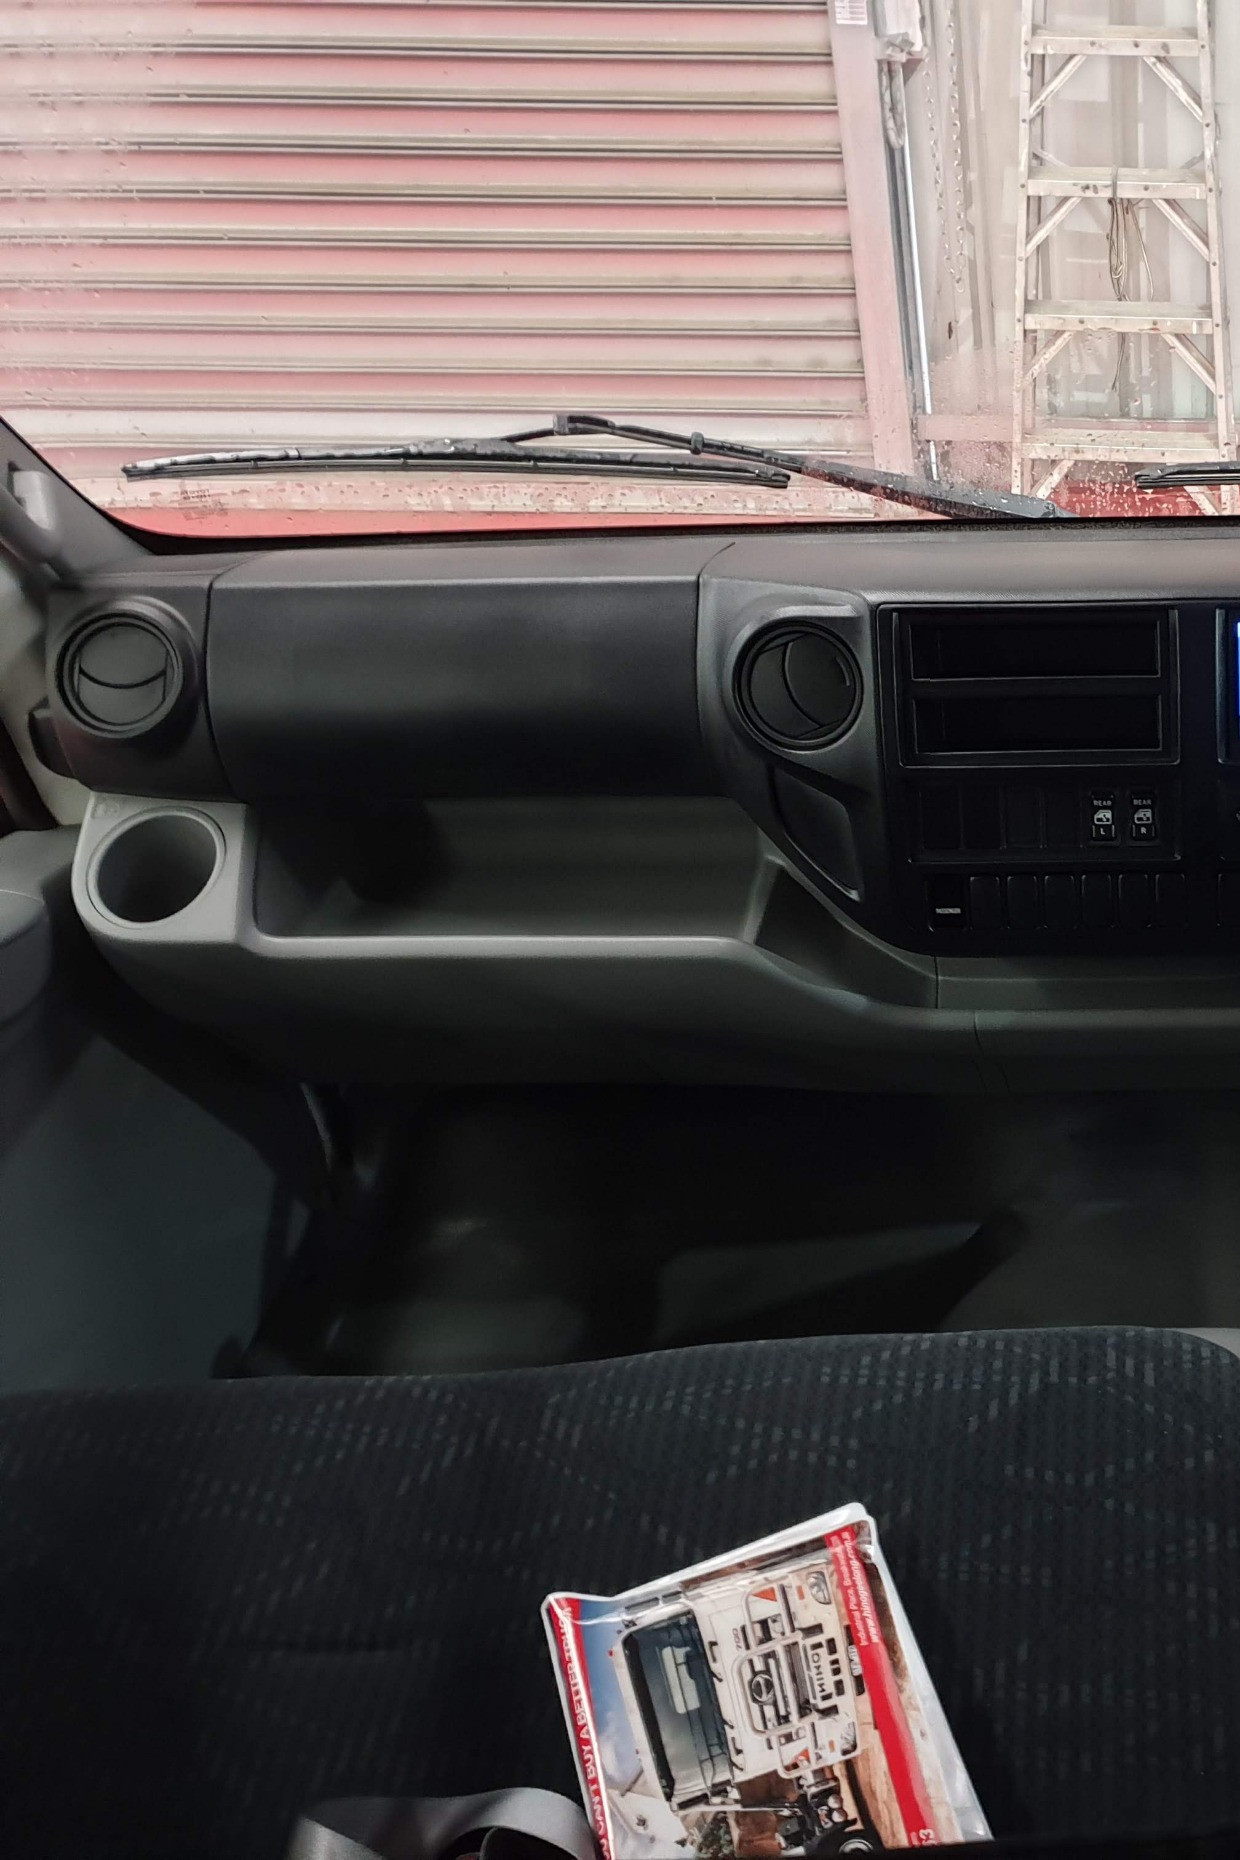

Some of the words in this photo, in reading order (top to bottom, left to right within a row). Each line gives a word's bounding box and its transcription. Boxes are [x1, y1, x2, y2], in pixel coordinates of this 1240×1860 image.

[566, 1662, 587, 1726] BETTER
[579, 1725, 591, 1739] A
[581, 1745, 596, 1780] BUY
